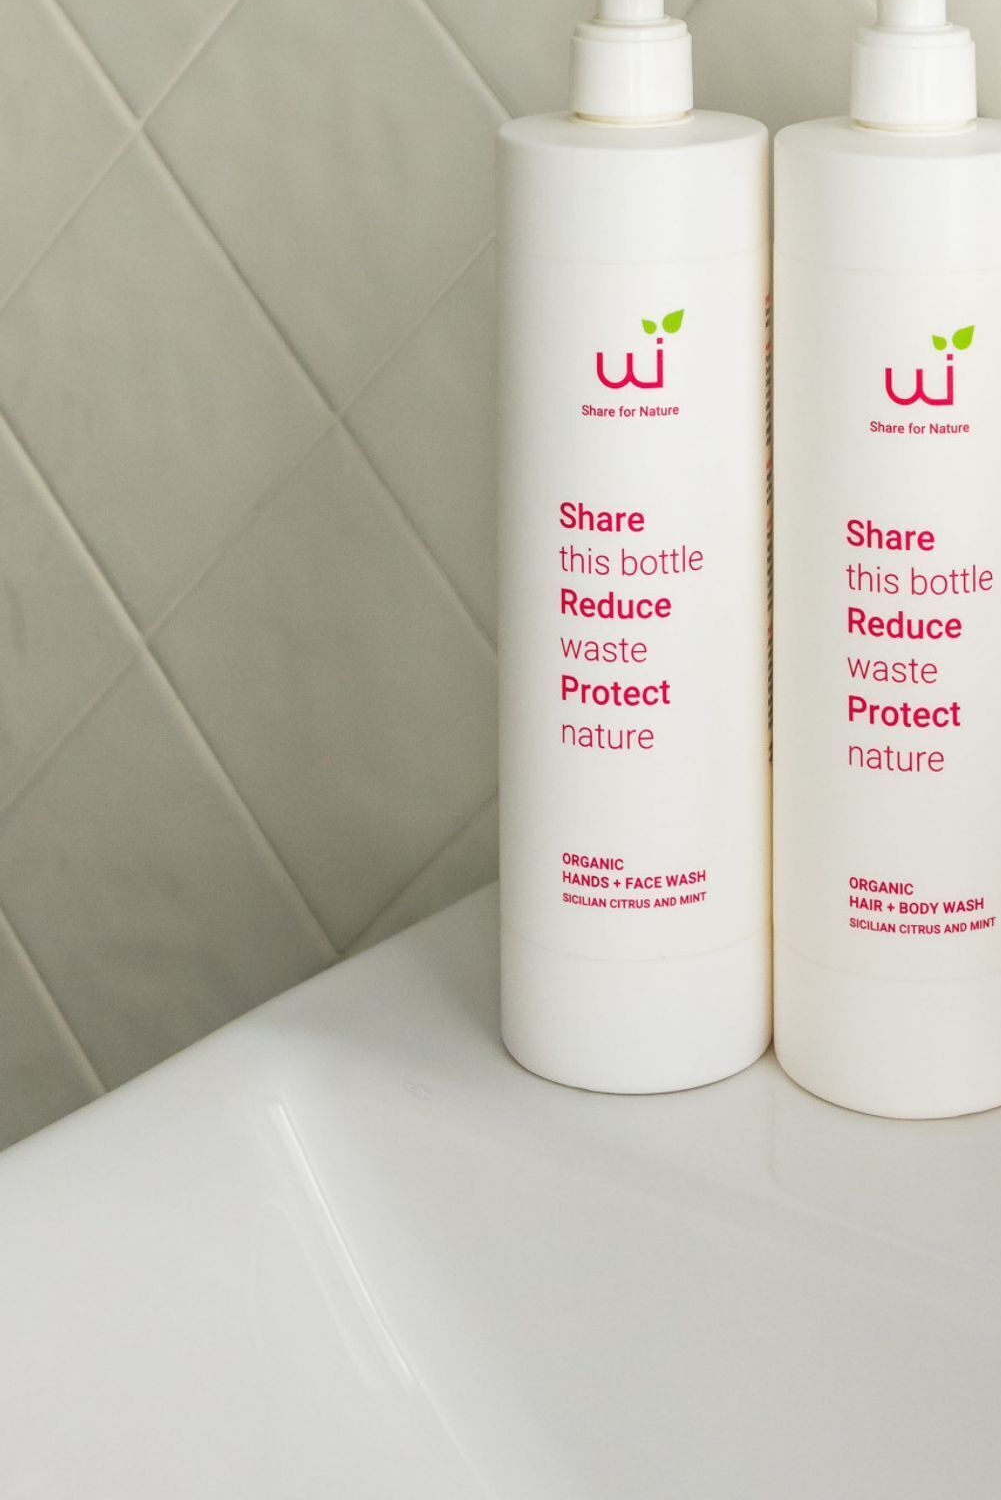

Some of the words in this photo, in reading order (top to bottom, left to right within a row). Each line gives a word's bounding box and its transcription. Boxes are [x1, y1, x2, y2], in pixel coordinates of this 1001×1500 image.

[581, 404, 616, 418] Share
[618, 404, 636, 418] for
[638, 406, 680, 418] Nature
[869, 420, 905, 435] Share
[907, 421, 926, 435] for
[929, 423, 970, 435] Nature
[559, 501, 646, 534] Share
[845, 518, 936, 552] Share
[559, 544, 611, 577] this
[620, 545, 704, 577] bottle
[845, 561, 900, 596] this
[909, 564, 994, 597] bottle
[559, 586, 673, 621] Reduce
[846, 605, 963, 641] Reduce
[560, 636, 649, 665] waste
[847, 655, 939, 685] waste
[560, 672, 672, 708] Protect
[847, 693, 962, 730] Protect
[560, 722, 655, 751] nature
[848, 742, 946, 773] nature
[561, 851, 624, 872] ORGANIC
[561, 870, 610, 890] HANDS
[612, 878, 622, 889] +
[624, 875, 663, 891] FACE
[665, 869, 707, 888] WASH
[848, 875, 914, 897] ORGANIC
[561, 892, 608, 909] SICILIAN
[609, 897, 652, 910] CITRUS
[653, 896, 678, 909] AND
[679, 890, 708, 906] MINT
[848, 894, 884, 913] HAIR
[886, 902, 896, 913] +
[898, 901, 940, 916] BODY
[942, 897, 985, 915] WASH
[848, 916, 897, 934] SICILIAN
[898, 923, 942, 936] CITRUS
[943, 921, 968, 935] AND
[969, 915, 997, 933] MINT
